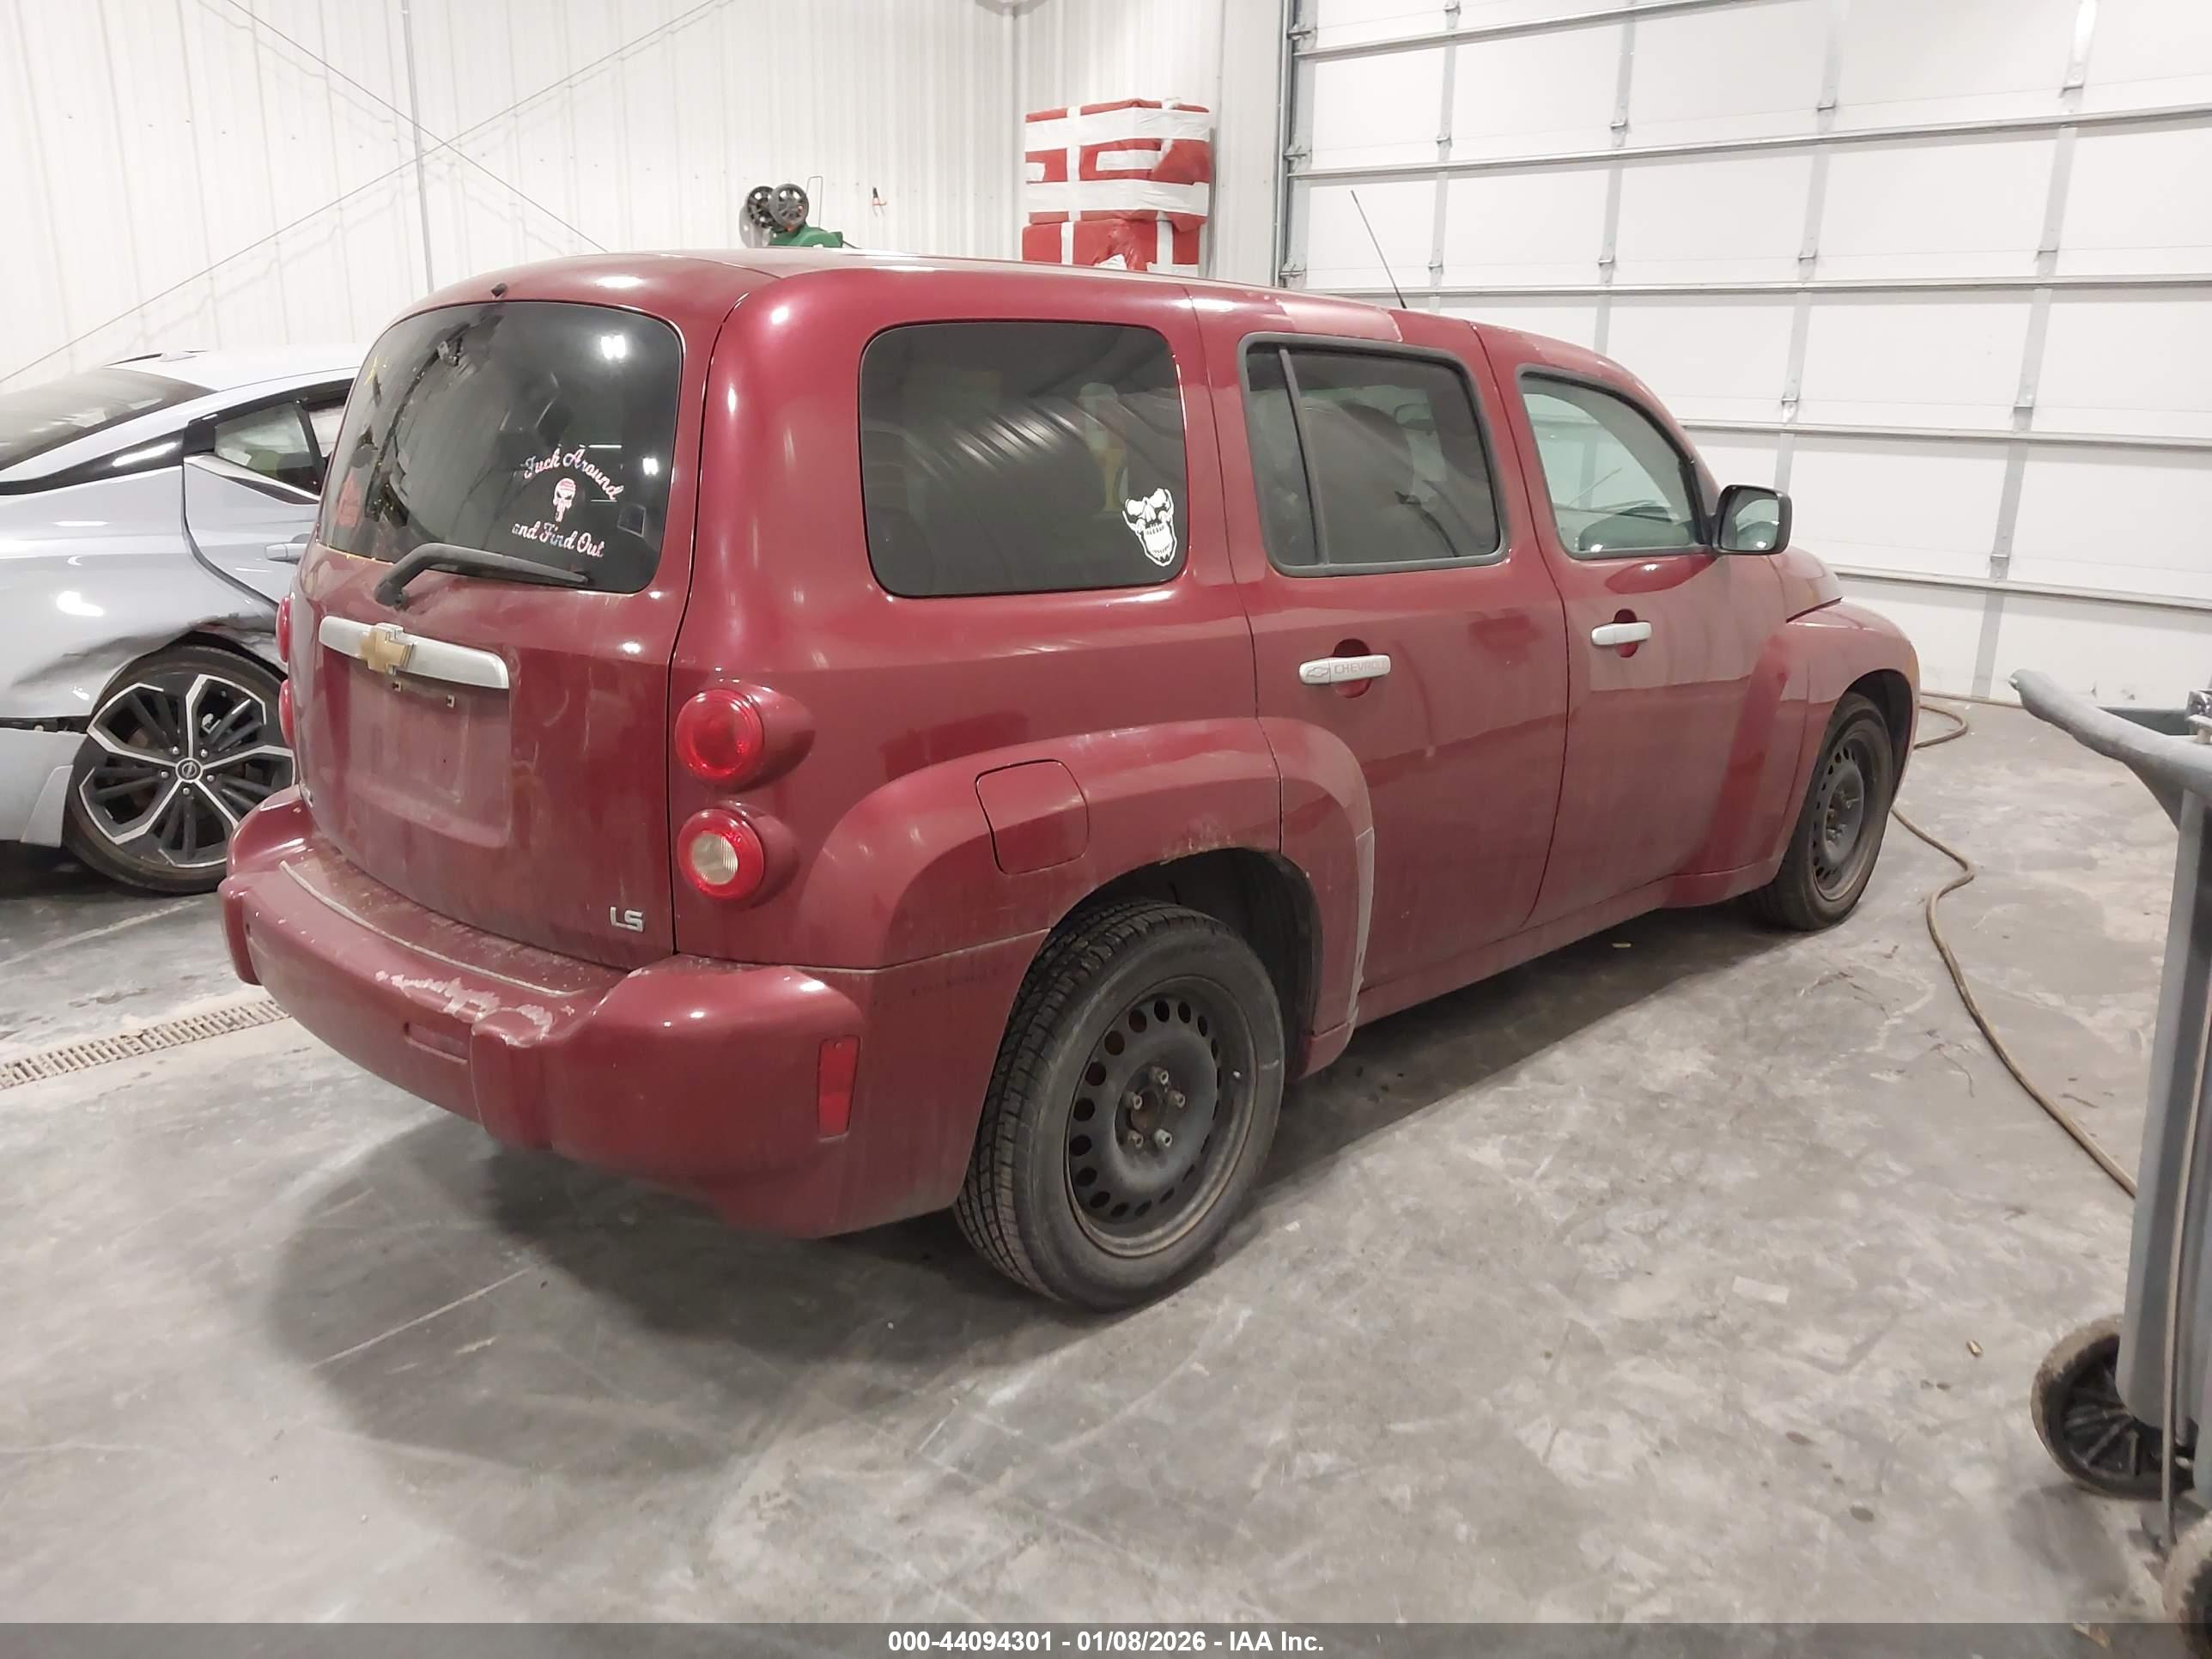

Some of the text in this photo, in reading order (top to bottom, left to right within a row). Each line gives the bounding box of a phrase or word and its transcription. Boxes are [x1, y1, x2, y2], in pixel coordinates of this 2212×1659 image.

[562, 448, 624, 500] Around
[512, 520, 605, 557] and Find Out
[610, 906, 643, 933] LS
